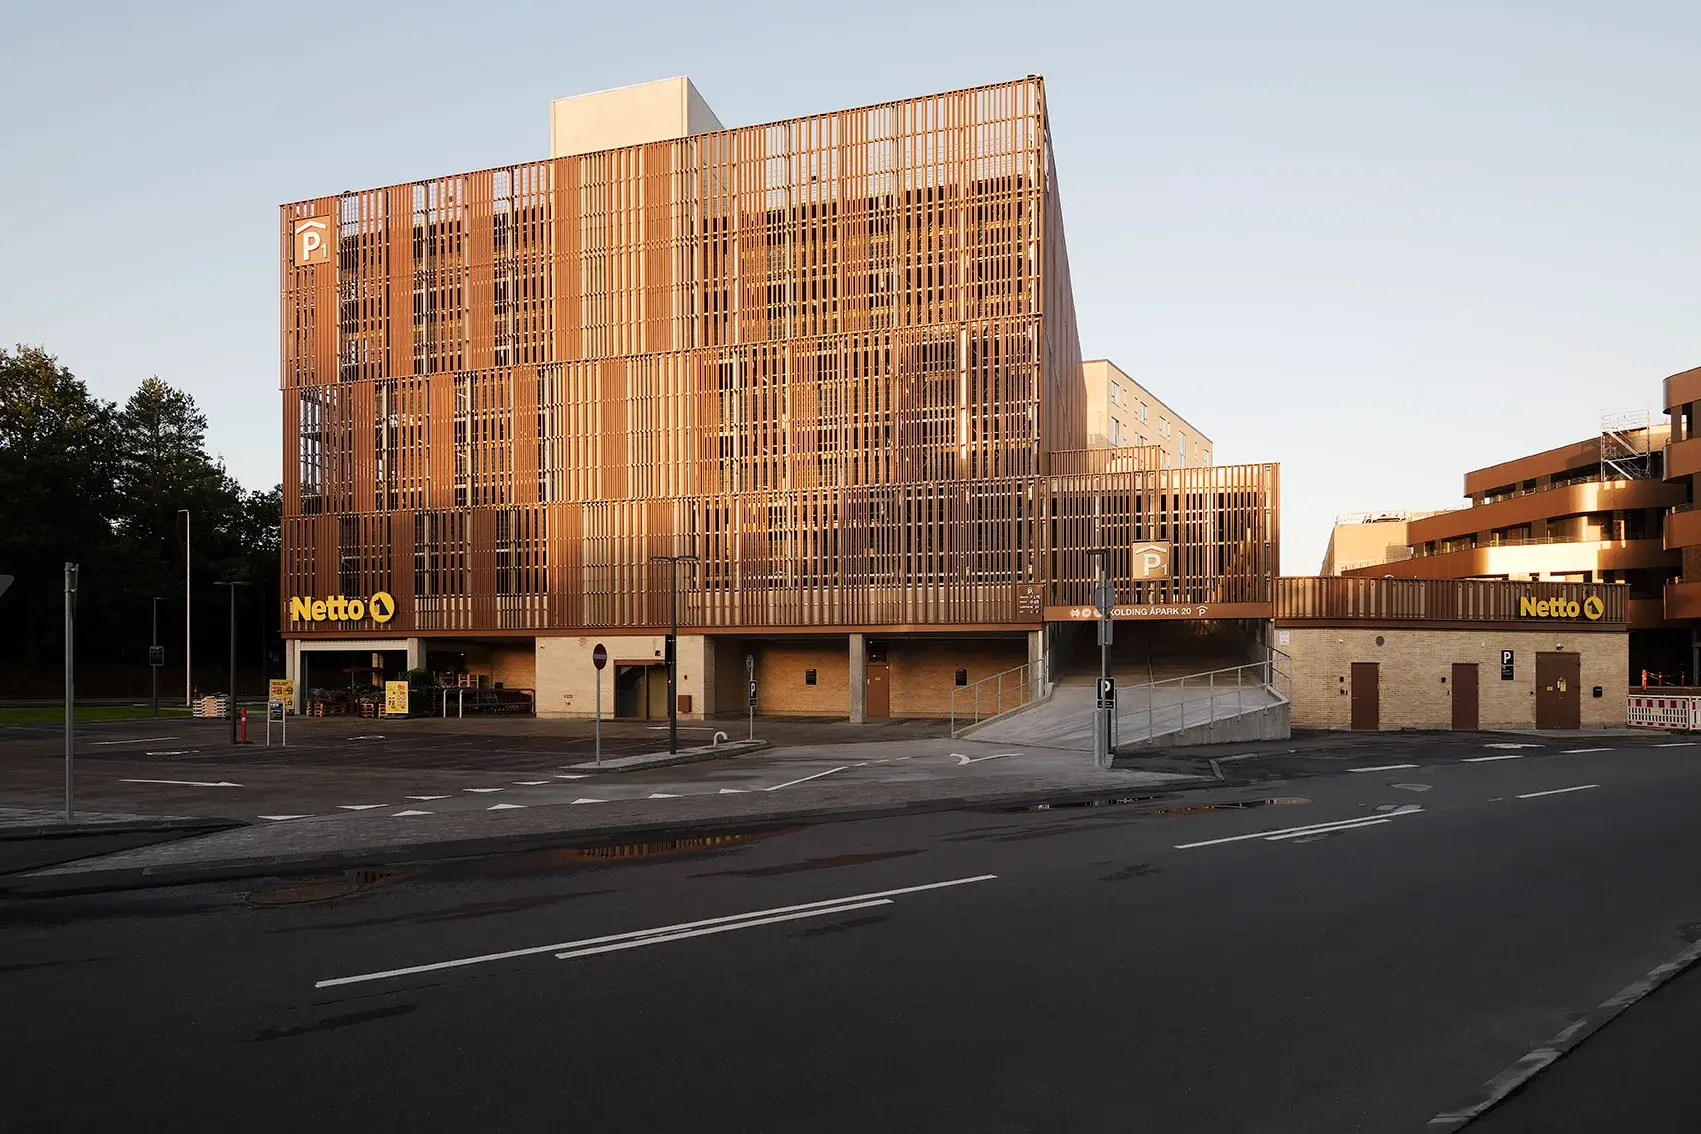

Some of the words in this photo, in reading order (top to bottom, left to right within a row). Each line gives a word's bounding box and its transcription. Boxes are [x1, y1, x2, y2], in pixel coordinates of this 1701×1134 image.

[292, 596, 364, 621] Netto
[1149, 606, 1179, 616] ÅPARK
[1181, 607, 1192, 616] 20
[1520, 597, 1580, 617] Netto
[1503, 651, 1512, 664] P
[750, 682, 756, 698] P
[1100, 680, 1111, 698] P
